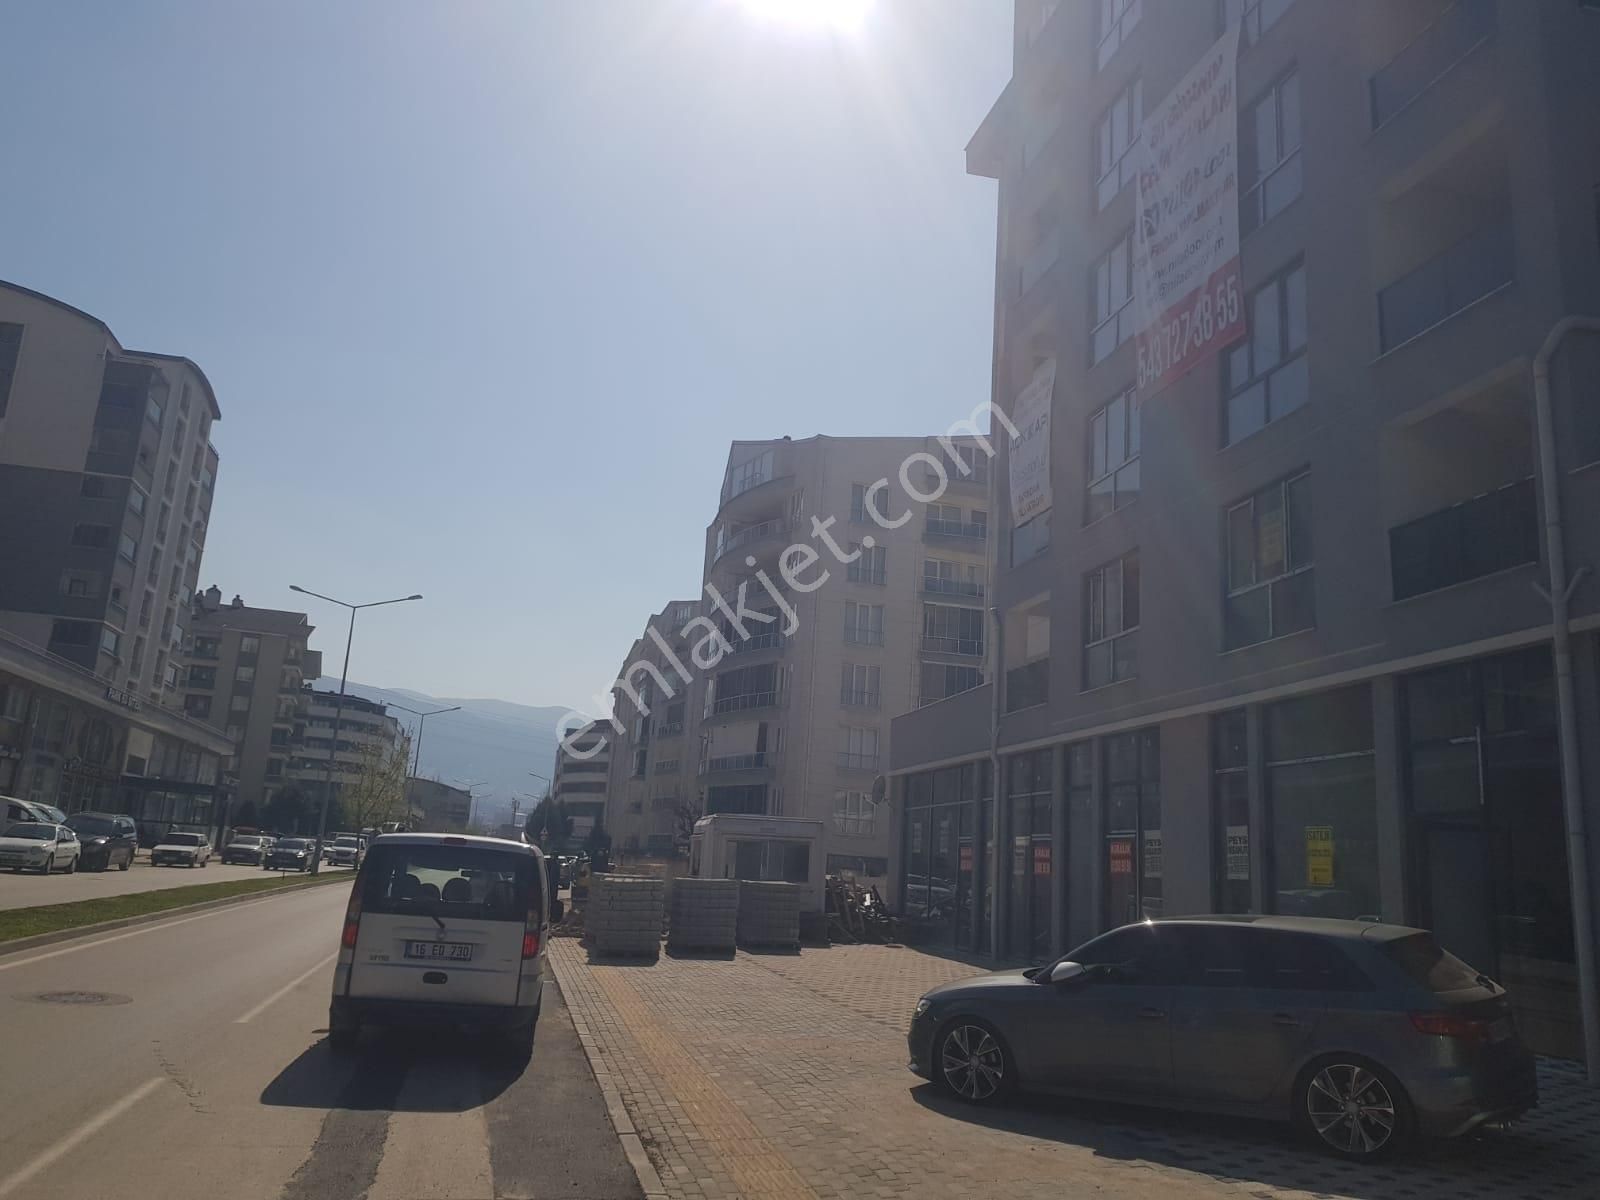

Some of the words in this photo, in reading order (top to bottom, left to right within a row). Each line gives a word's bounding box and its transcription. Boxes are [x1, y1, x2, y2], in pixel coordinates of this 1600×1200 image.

[1165, 311, 1190, 369] 727
[1217, 275, 1239, 331] 55
[416, 943, 426, 955] 16
